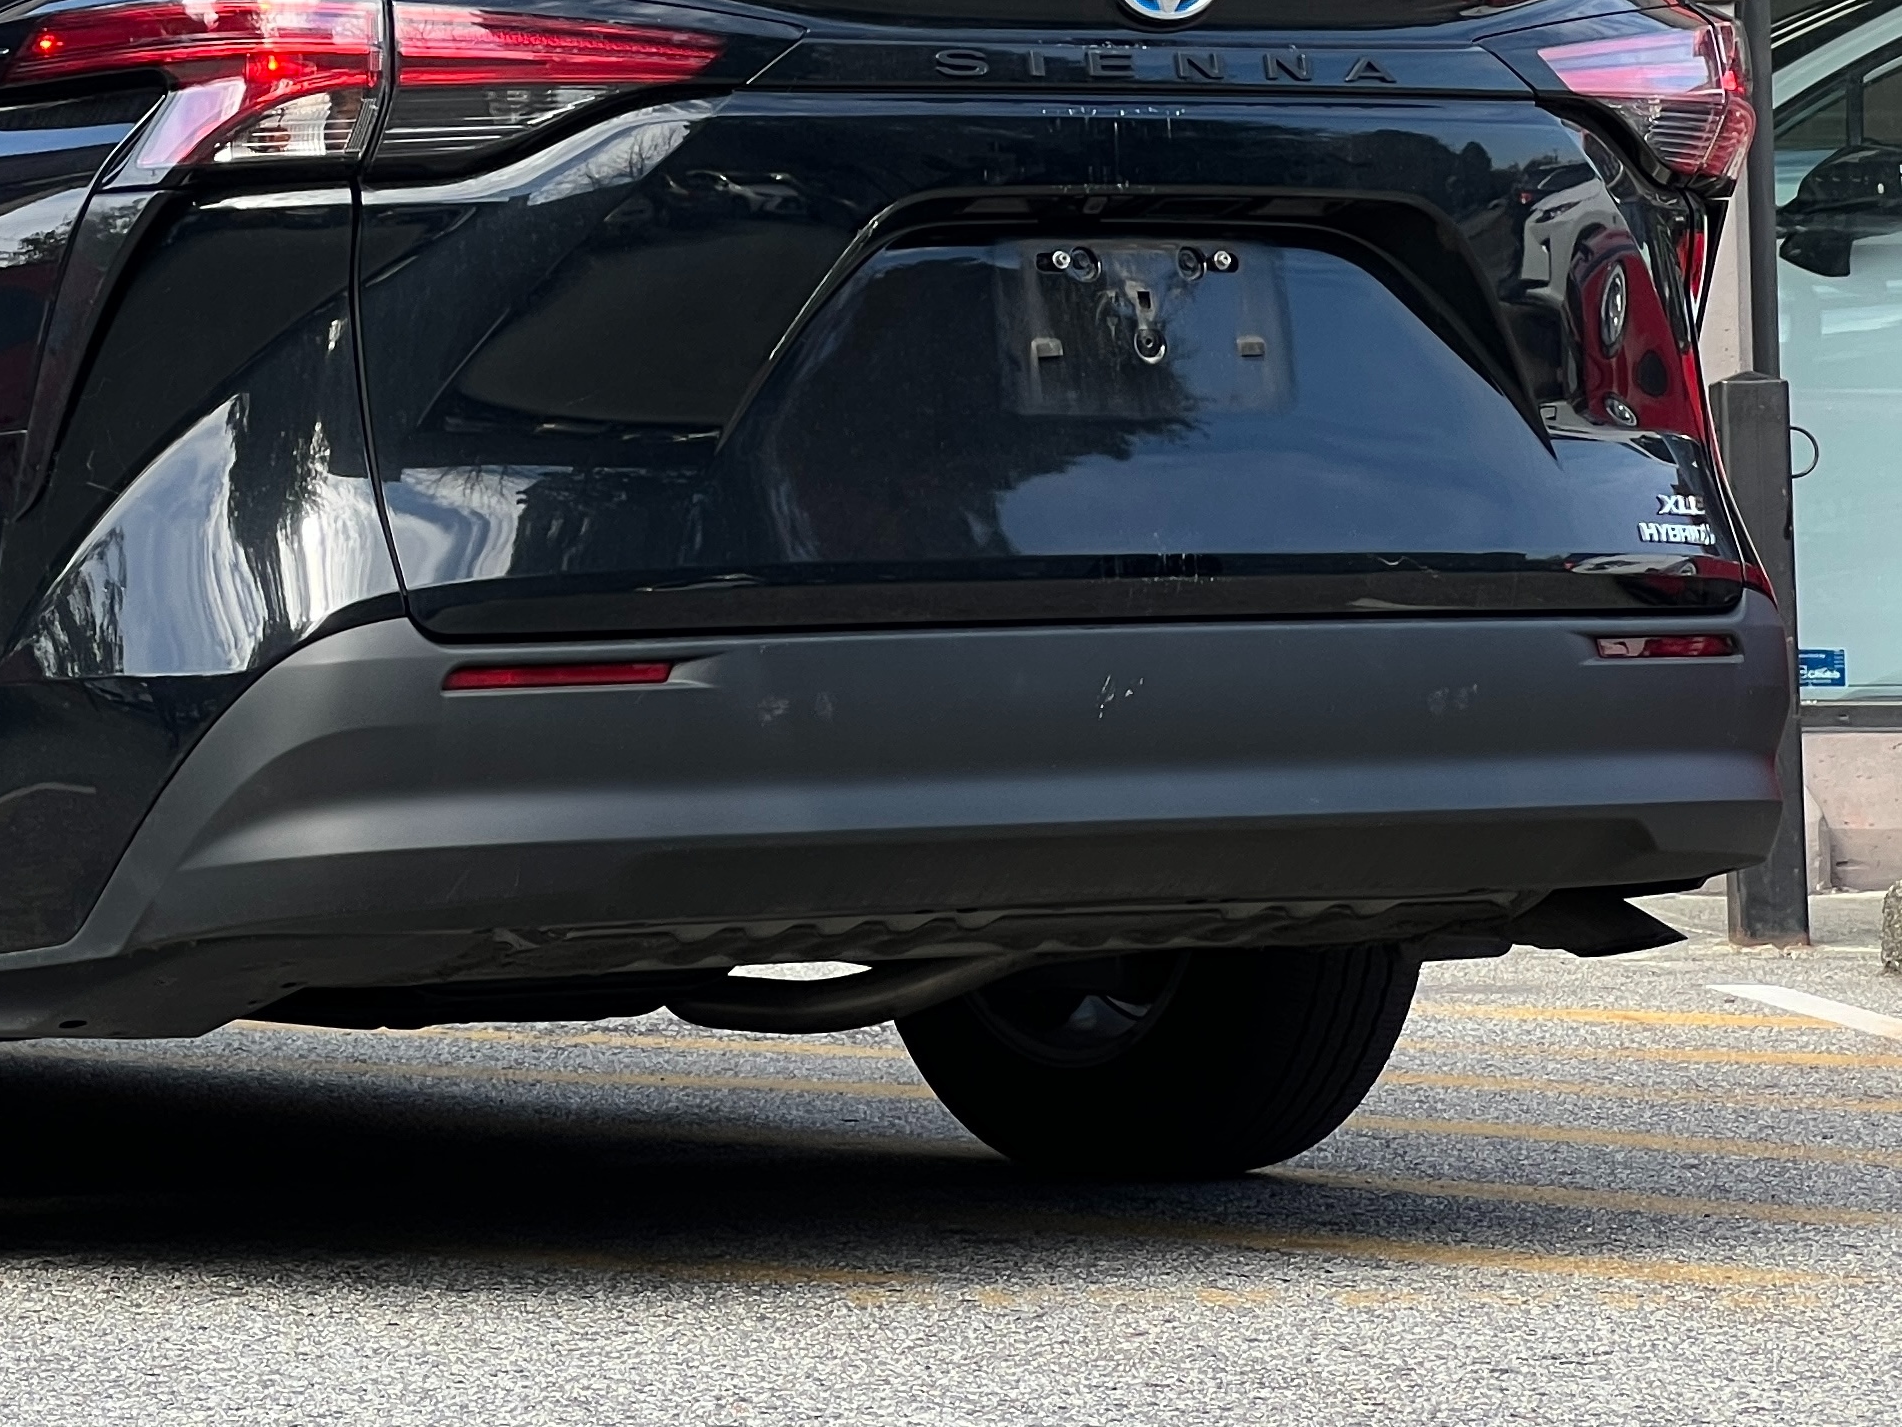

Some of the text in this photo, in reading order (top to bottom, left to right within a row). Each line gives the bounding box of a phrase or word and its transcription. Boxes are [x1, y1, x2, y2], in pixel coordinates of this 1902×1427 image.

[935, 49, 1398, 83] SIENNA
[1656, 493, 1706, 515] XLE
[1638, 522, 1716, 545] HYBRID
